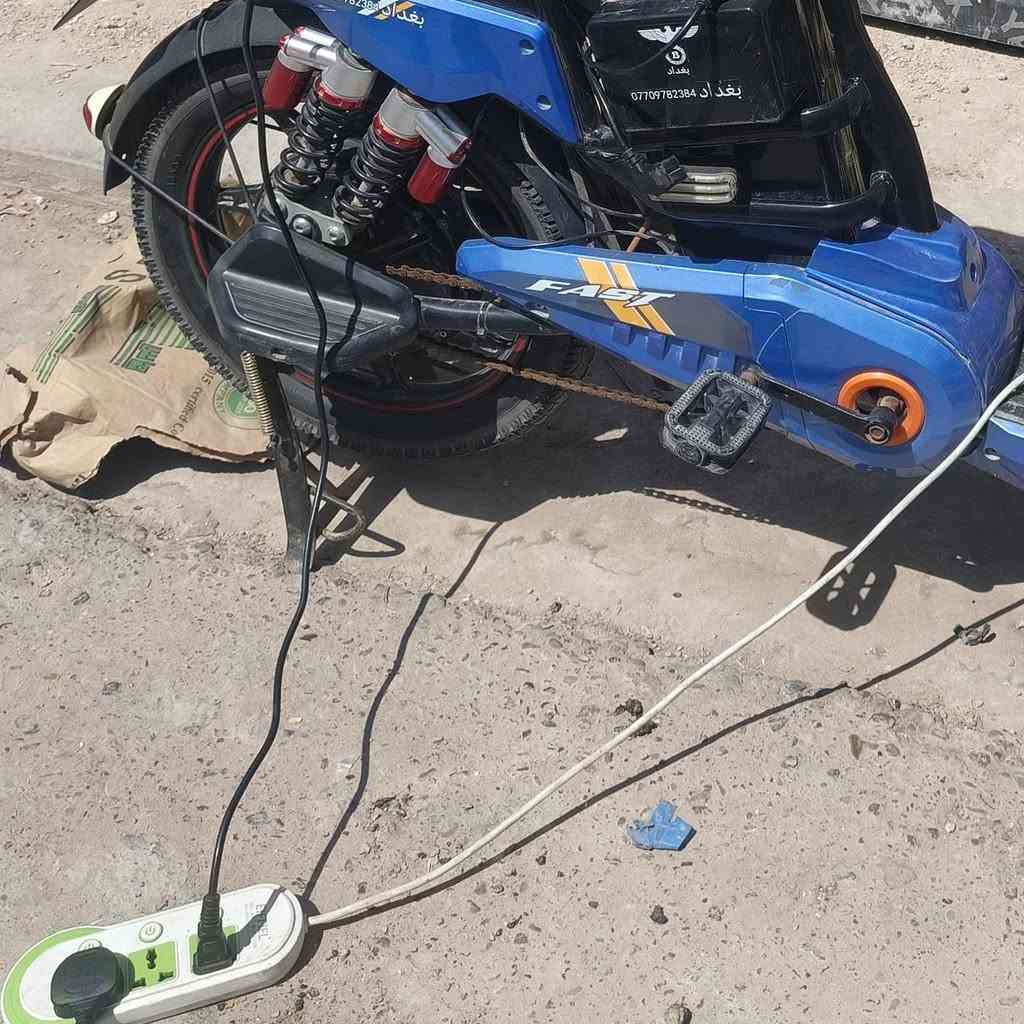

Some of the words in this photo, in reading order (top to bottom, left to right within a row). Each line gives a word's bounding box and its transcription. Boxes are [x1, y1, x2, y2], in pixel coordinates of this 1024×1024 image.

[382, 2, 425, 29] بغداد
[666, 66, 690, 76] بغداد
[631, 88, 696, 101] 07709782384
[699, 81, 742, 99] بغداد
[525, 279, 676, 308] FAST
[178, 386, 202, 423] certified
